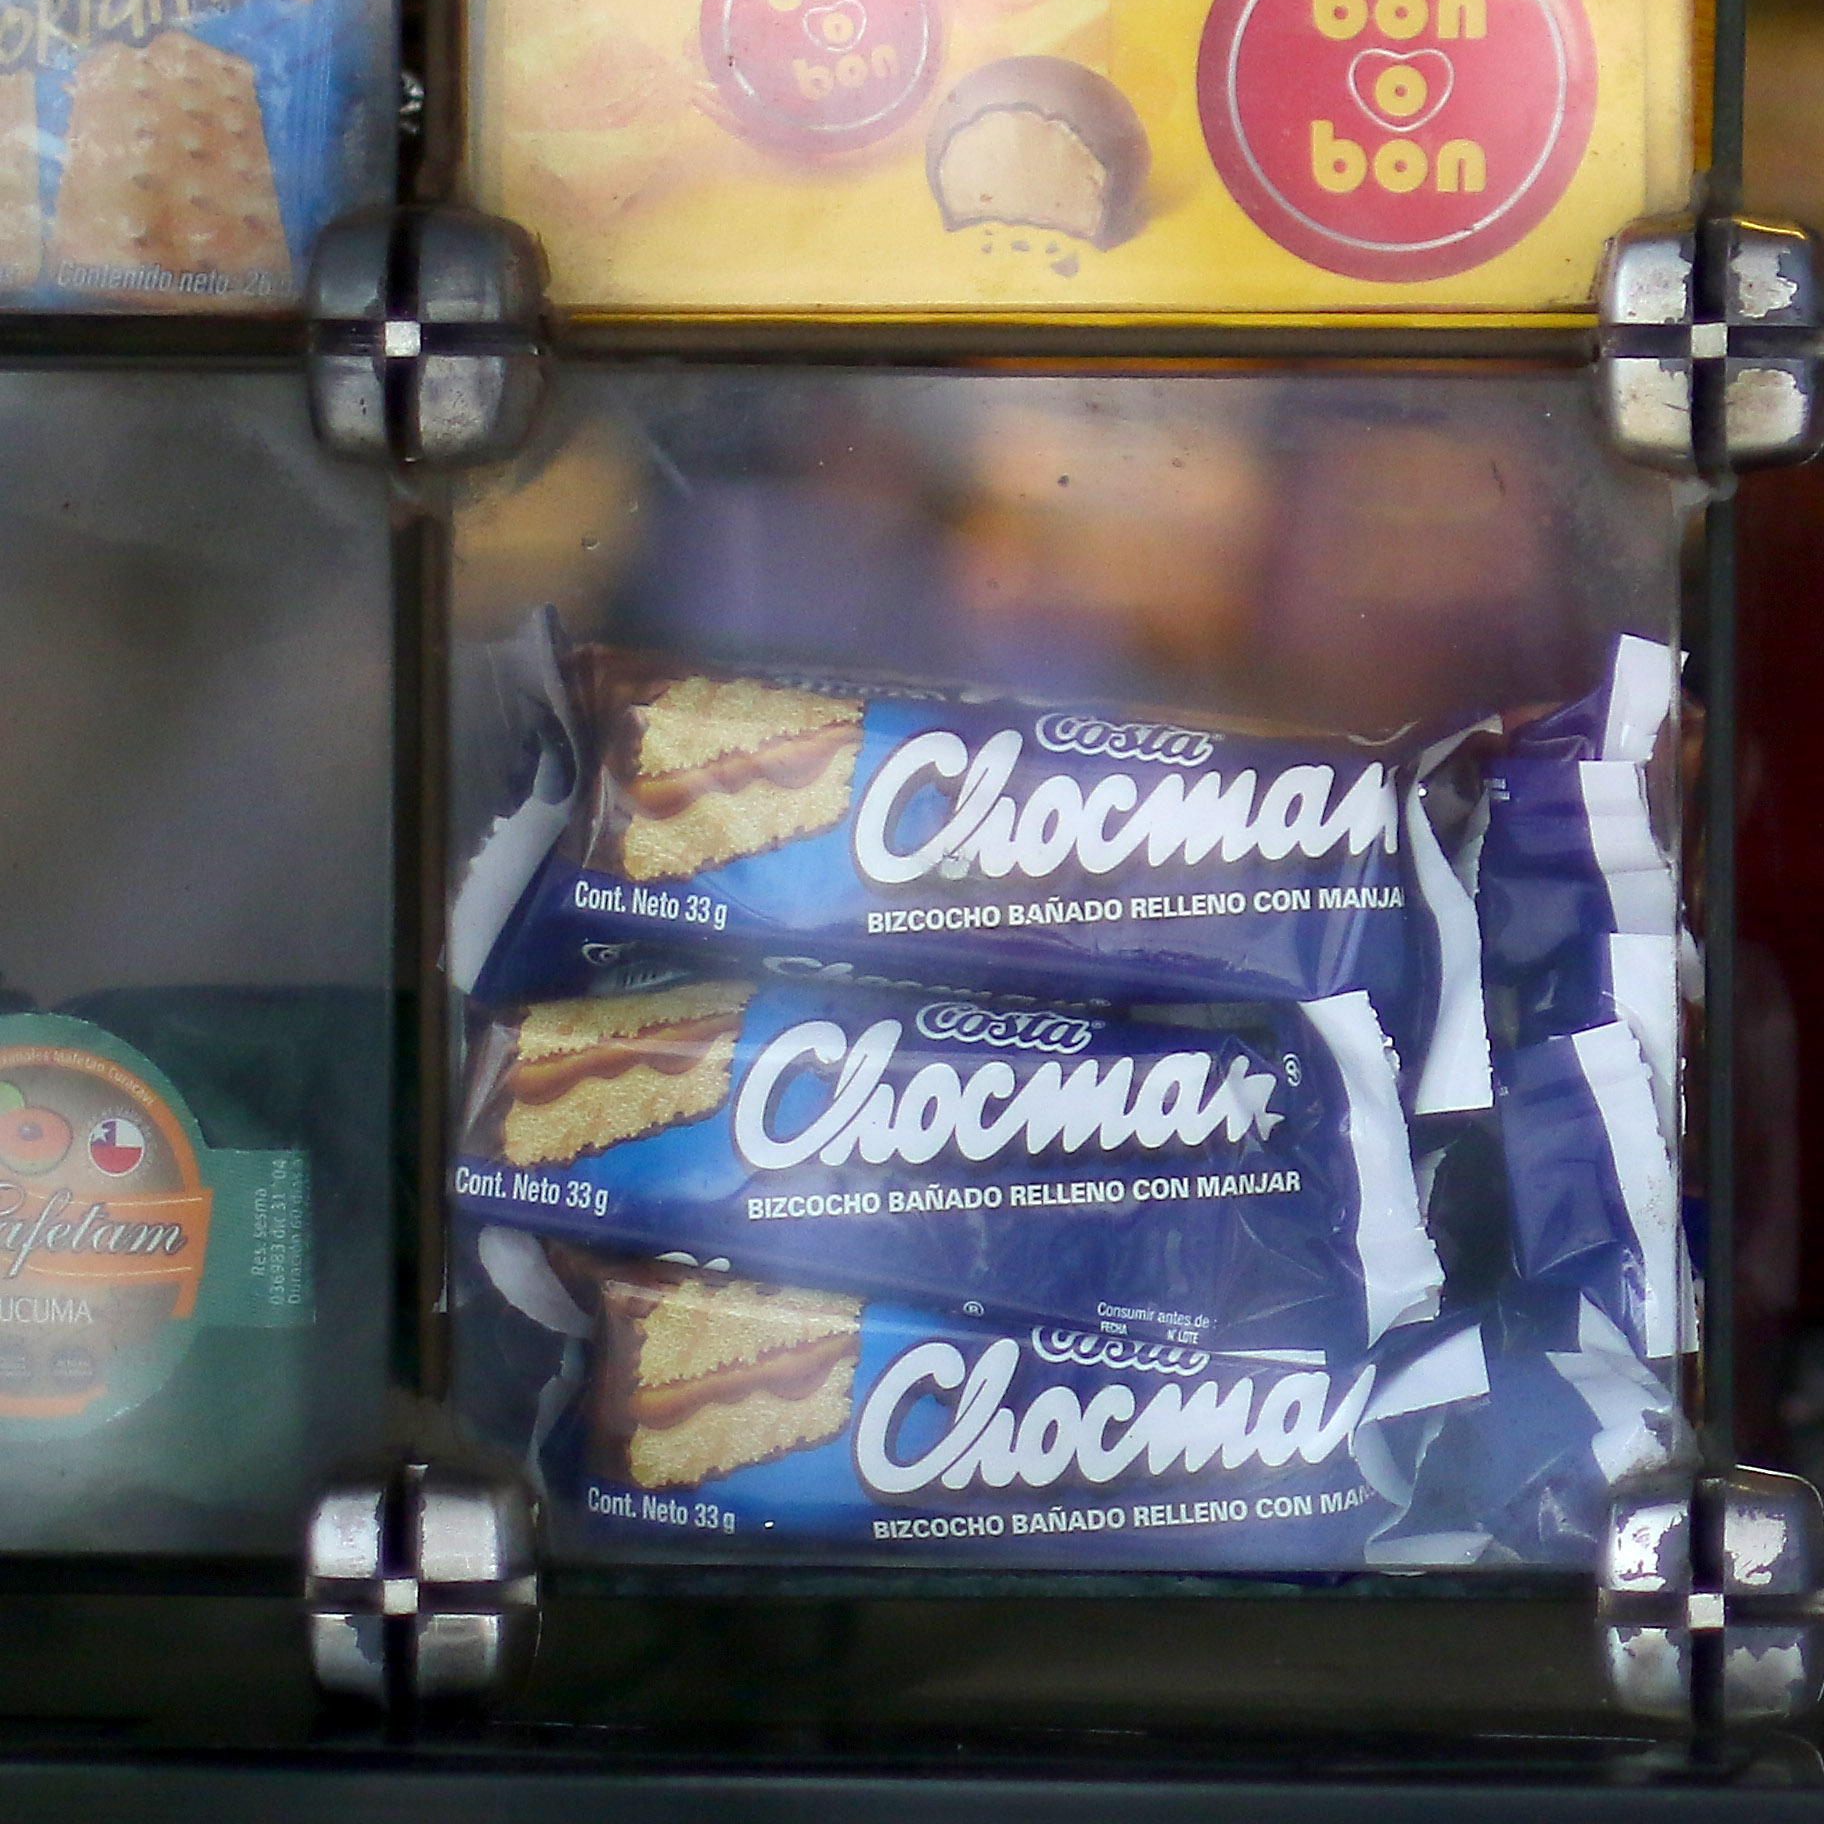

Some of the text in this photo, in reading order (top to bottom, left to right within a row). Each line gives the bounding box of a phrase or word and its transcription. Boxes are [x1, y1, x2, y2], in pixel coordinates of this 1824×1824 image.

[791, 44, 898, 102] bon
[1310, 119, 1488, 194] bon
[56, 258, 175, 292] Contenido
[573, 879, 729, 933] Cont. Neto 33 g
[867, 885, 1406, 935] BIZCOCHO BAÑADO RELLENO CON MANJA
[733, 1018, 1286, 1171] Chocman
[453, 1166, 609, 1218] Cont. Neto 33 g
[747, 1169, 1302, 1222] BIZCOCHO BAÑADO RELLENO CON MANJAR
[1096, 1301, 1211, 1329] Consumir antes de
[1099, 1320, 1129, 1337] FECHA
[587, 1486, 737, 1535] Cont. Neto 33 g
[872, 1514, 1005, 1541] BIZCOCHO
[1011, 1505, 1127, 1536] BAÑADO
[1132, 1499, 1249, 1528] RELLENO
[1254, 1494, 1314, 1519] CON
